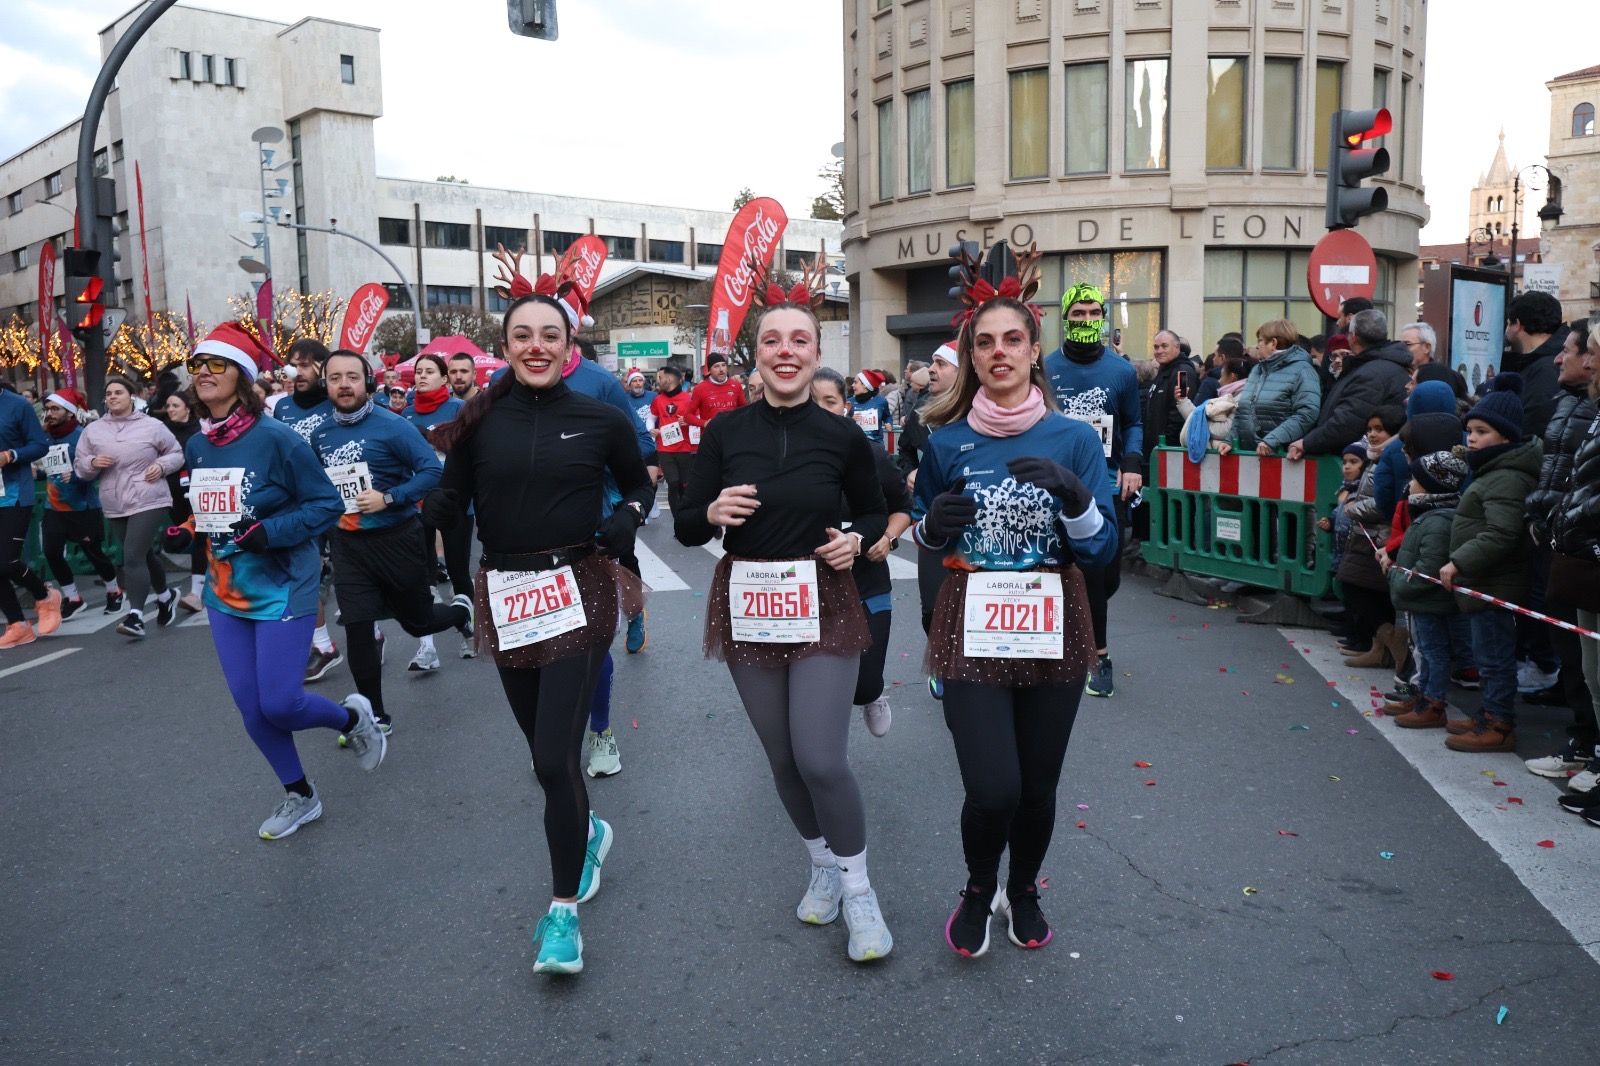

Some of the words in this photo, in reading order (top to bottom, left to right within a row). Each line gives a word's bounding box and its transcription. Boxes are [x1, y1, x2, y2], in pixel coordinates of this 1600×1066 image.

[898, 223, 1033, 259] MUSEO
[1078, 217, 1133, 243] DE
[1180, 214, 1302, 240] LEON
[198, 491, 226, 513] 1976
[746, 571, 780, 579] LABORAL
[986, 581, 1025, 590] LABORAL
[504, 584, 561, 623] 2226
[743, 591, 798, 618] 2065
[985, 603, 1038, 631] 2021
